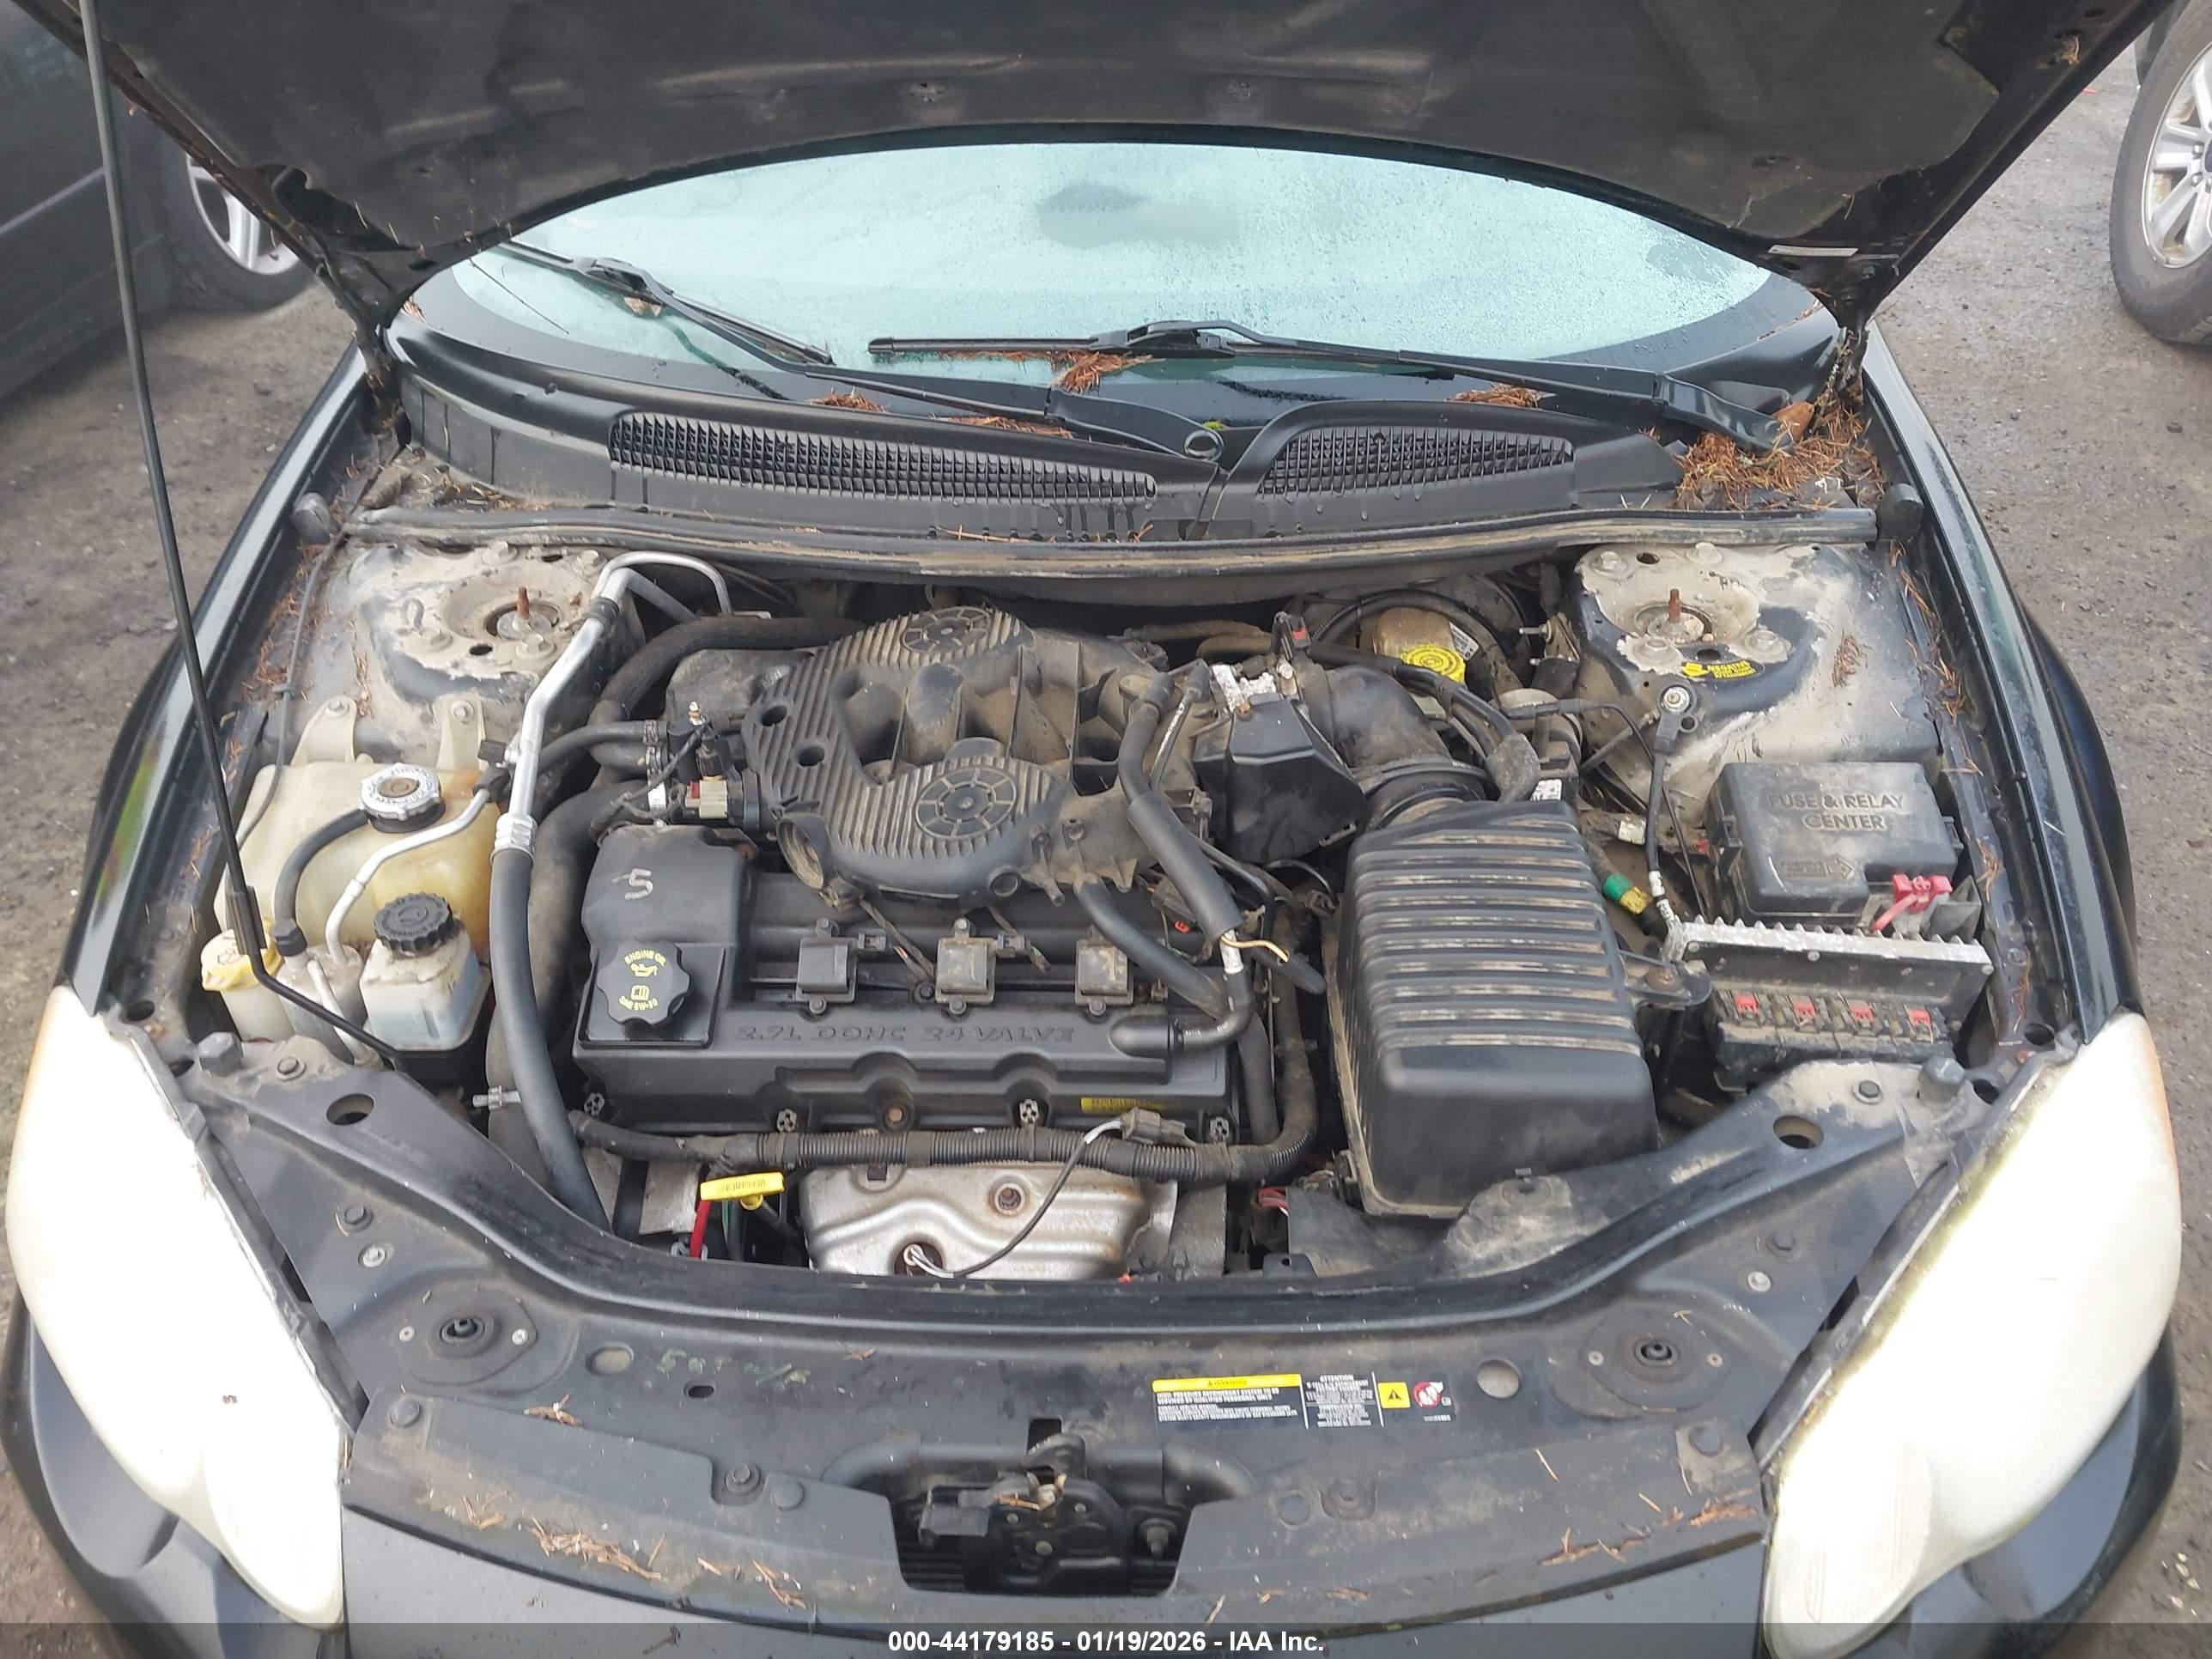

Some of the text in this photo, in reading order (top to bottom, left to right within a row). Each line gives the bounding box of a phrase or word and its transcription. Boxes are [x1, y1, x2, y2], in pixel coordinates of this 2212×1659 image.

[1769, 794, 1905, 810] FUSE & RELAY
[1803, 813, 1887, 830] CENTER
[624, 950, 666, 967] ENGINE OIL
[619, 996, 634, 1010] SAE
[734, 1027, 1074, 1042] 2.7L DOHC 24 VALVE
